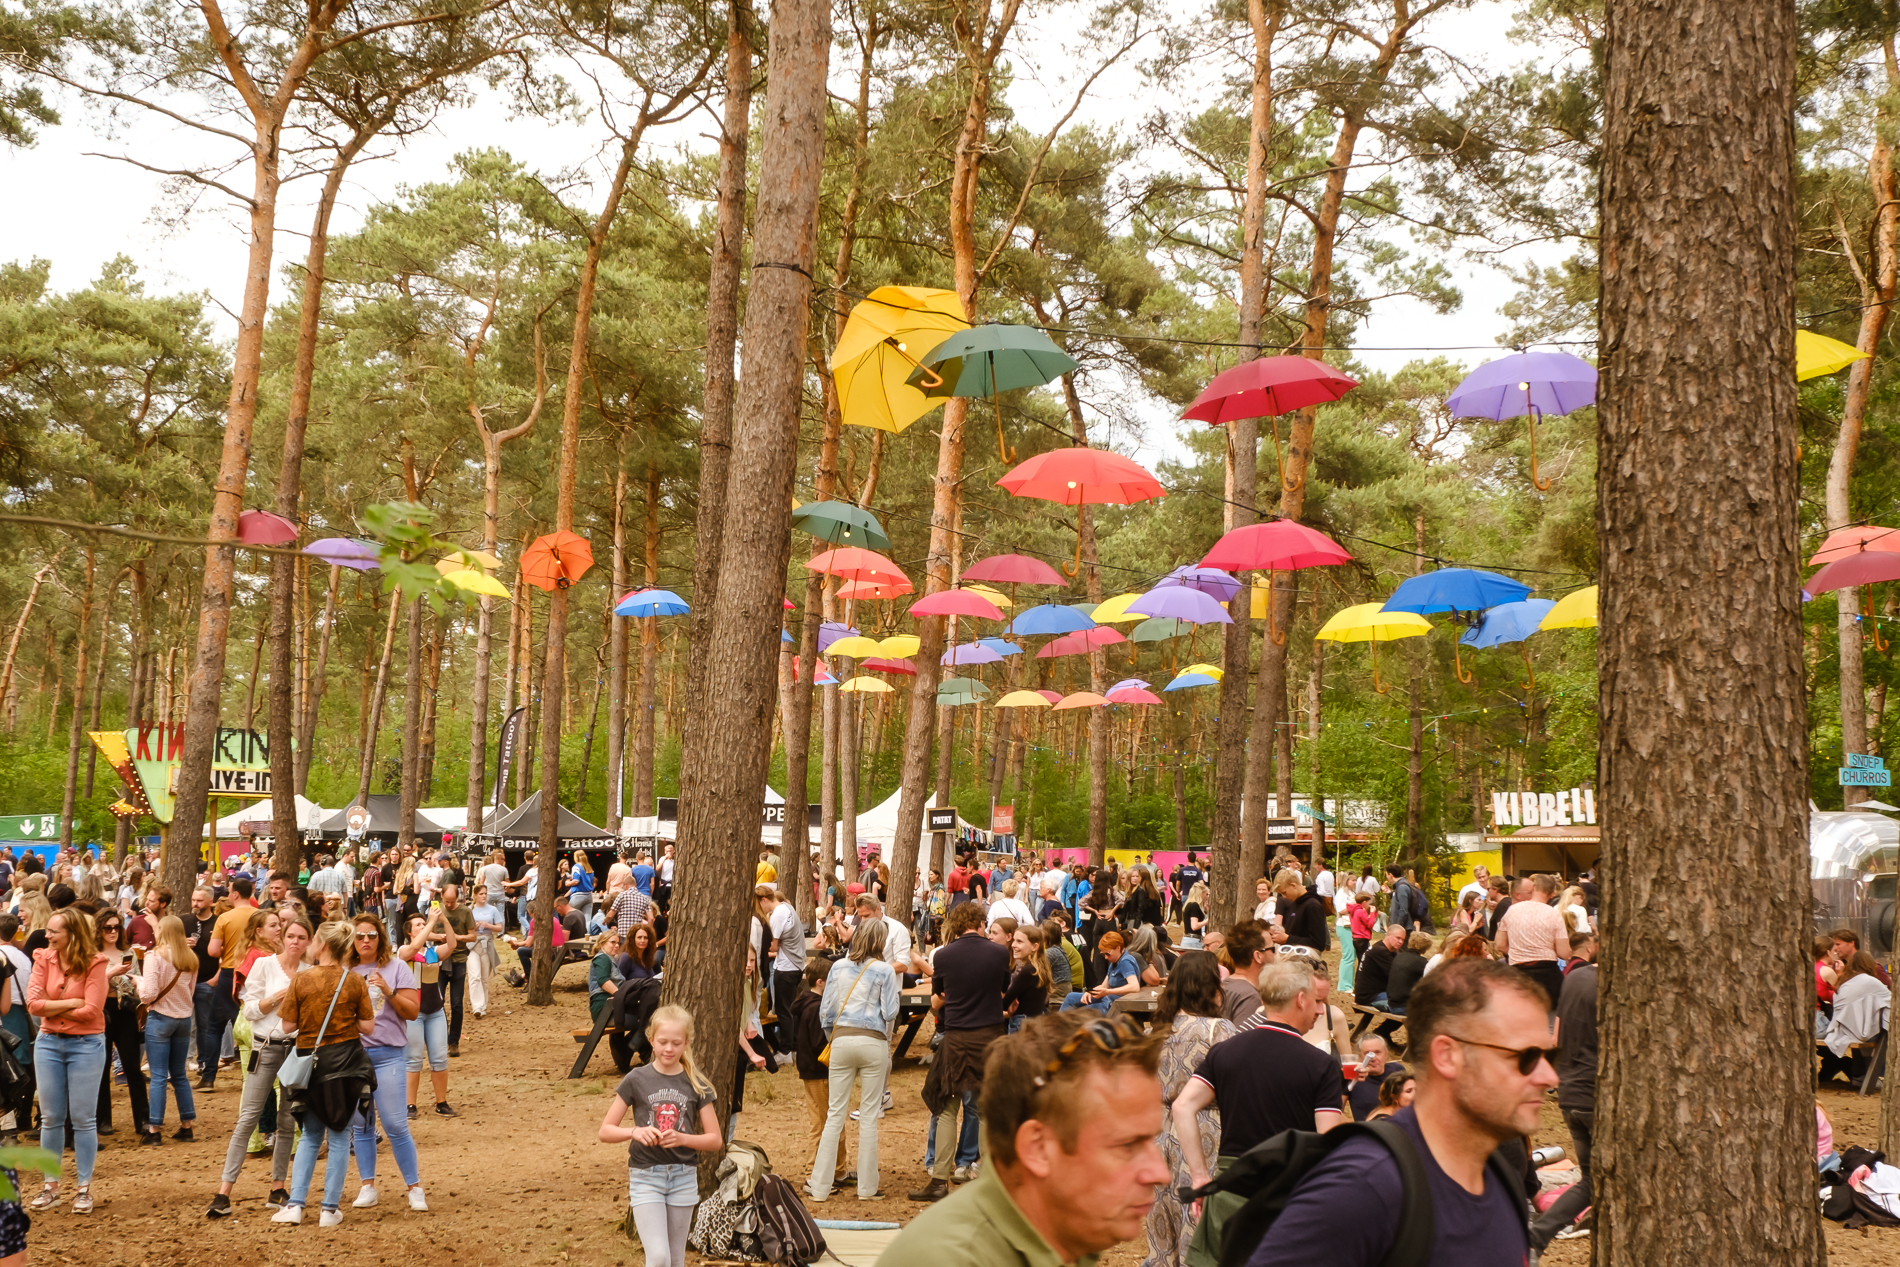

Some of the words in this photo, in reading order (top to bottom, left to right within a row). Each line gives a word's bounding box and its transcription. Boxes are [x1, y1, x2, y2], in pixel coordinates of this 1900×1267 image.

[503, 716, 517, 765] Tattoo's
[1853, 755, 1879, 768] SNOEP
[1843, 771, 1887, 783] CHURROS
[1493, 788, 1596, 827] KIBBELI
[932, 815, 952, 824] PATAT
[1268, 826, 1295, 834] SNACKS
[562, 838, 616, 848] Tattoo
